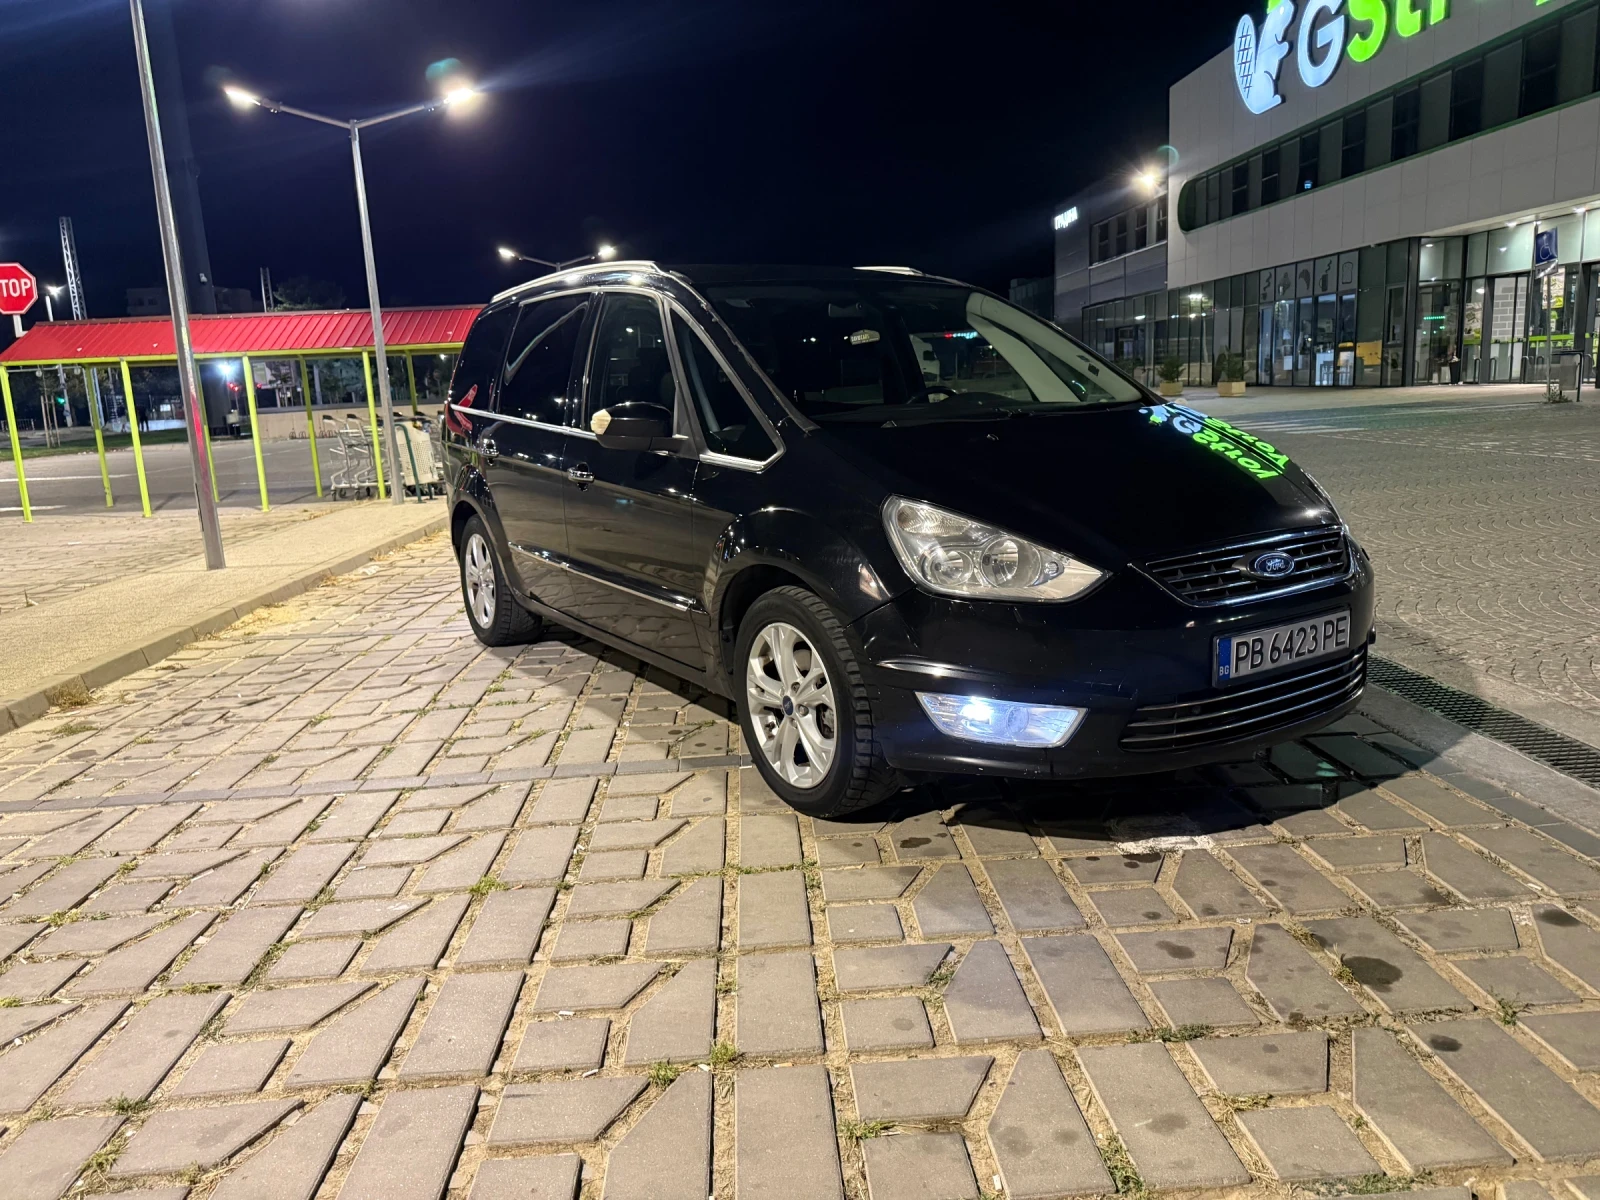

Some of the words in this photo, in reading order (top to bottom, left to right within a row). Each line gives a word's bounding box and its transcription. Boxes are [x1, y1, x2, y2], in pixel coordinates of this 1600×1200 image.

[0, 278, 31, 297] TOP
[1265, 558, 1286, 571] Ford
[1234, 636, 1264, 673] PB
[1268, 623, 1318, 664] 6423
[1322, 616, 1347, 651] PE
[1218, 665, 1230, 677] BG
